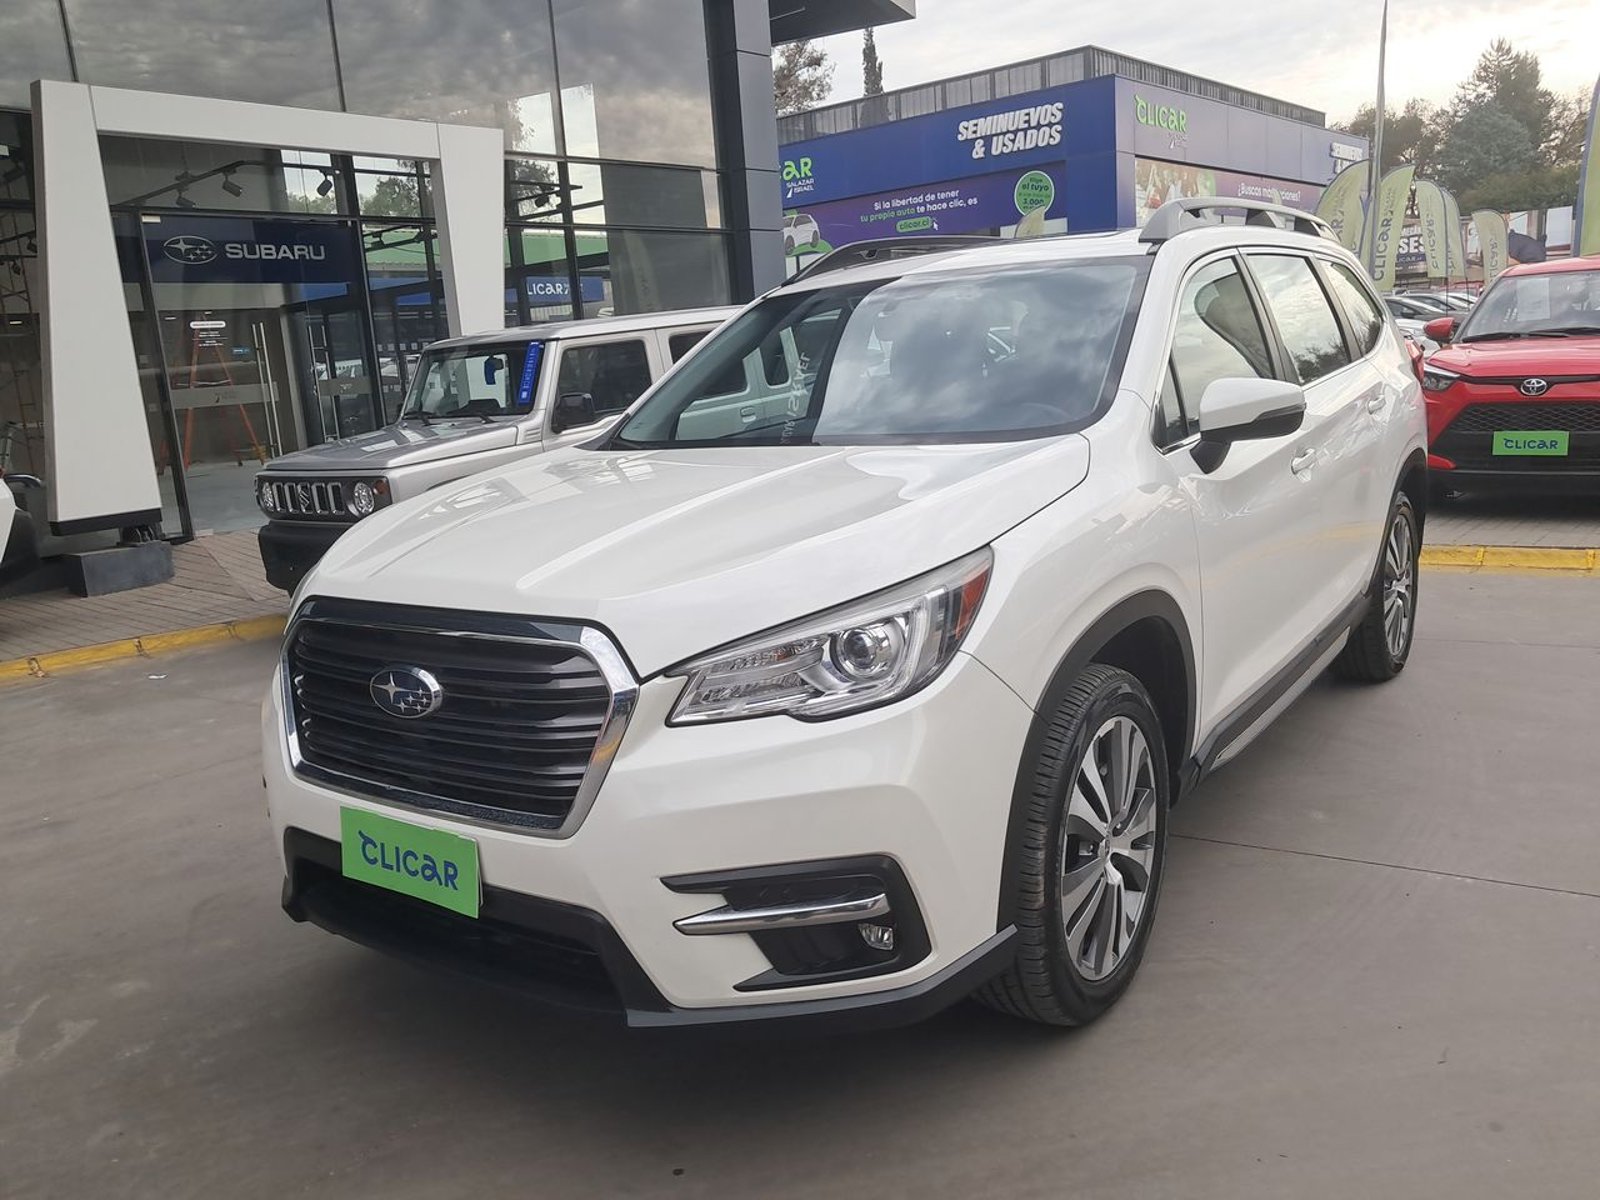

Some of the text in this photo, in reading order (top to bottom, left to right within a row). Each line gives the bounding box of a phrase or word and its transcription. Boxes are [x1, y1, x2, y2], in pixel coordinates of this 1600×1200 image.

[957, 102, 1064, 141] SEMINUEVOS
[972, 124, 1062, 159] & USADOS
[860, 214, 869, 222] tu
[869, 209, 896, 222] propio
[896, 207, 916, 217] auto
[916, 205, 926, 213] te
[926, 202, 947, 212] hace
[968, 197, 978, 205] es
[873, 190, 960, 211] Si la libertad de tener
[225, 243, 325, 260] SUBARU
